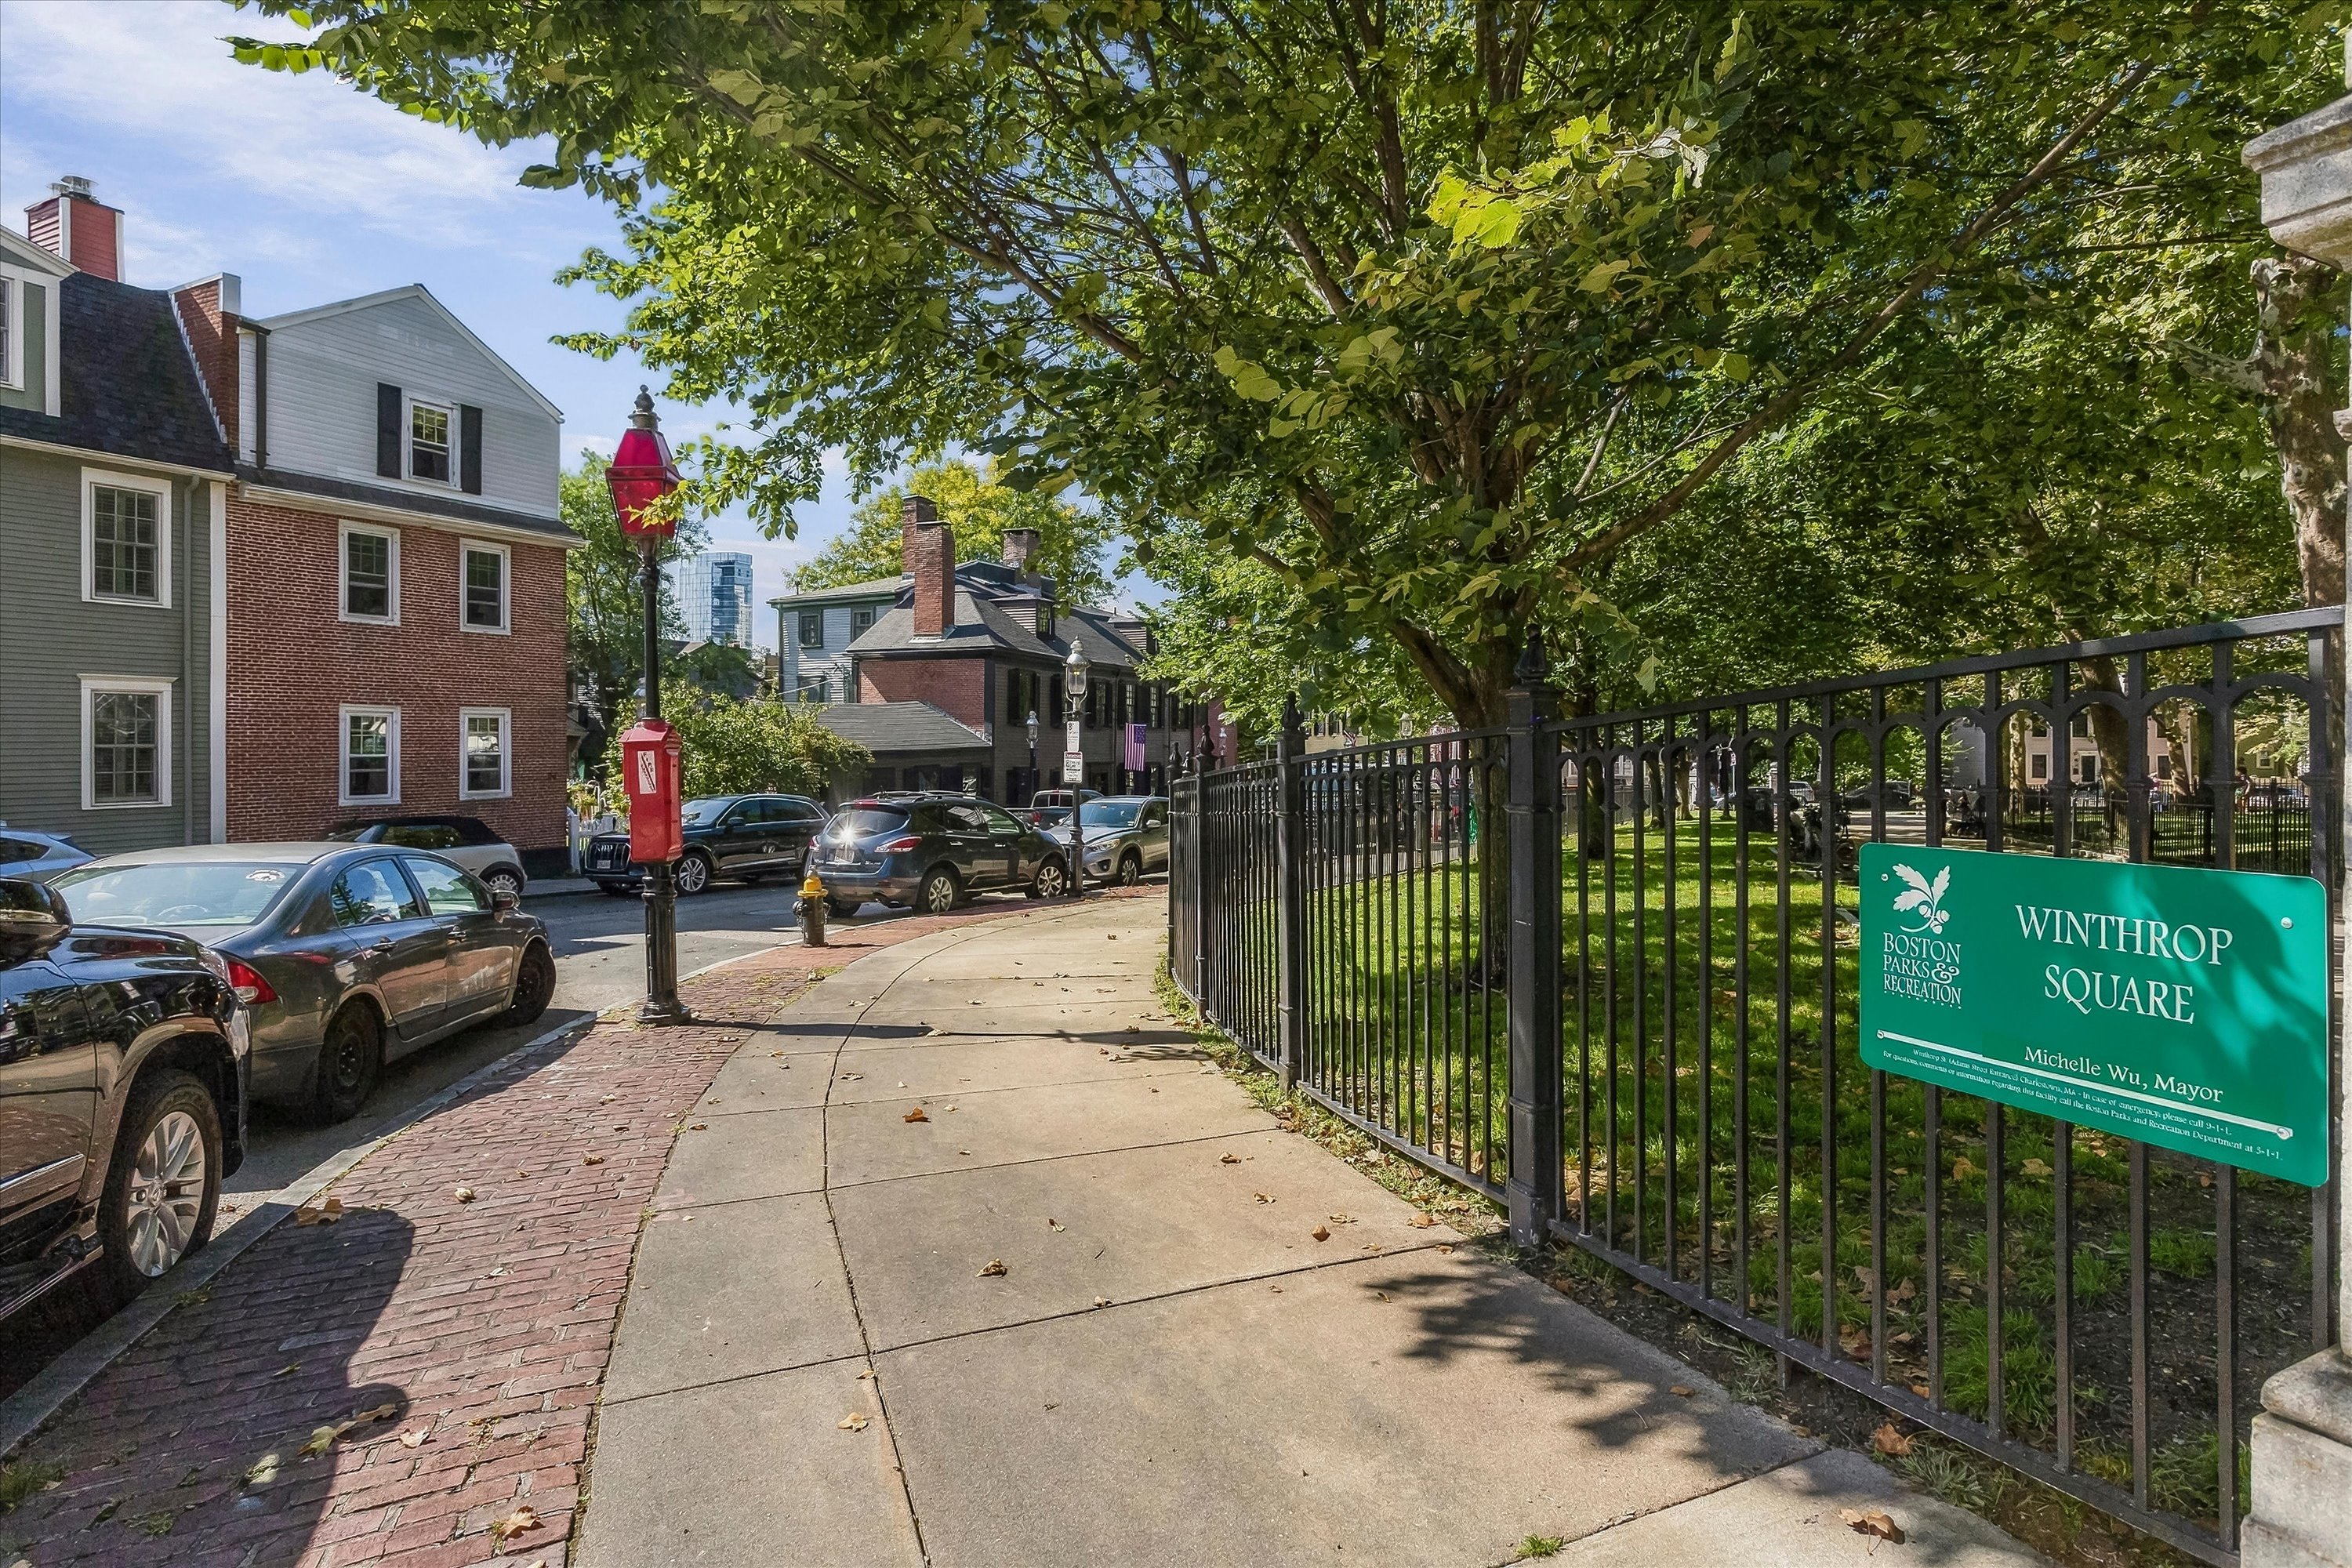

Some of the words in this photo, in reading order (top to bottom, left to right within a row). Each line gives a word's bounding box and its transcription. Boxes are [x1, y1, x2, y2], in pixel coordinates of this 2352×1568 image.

[1883, 931, 1962, 964] BOSTON
[2014, 904, 2234, 965] WINTHROP
[1883, 954, 1929, 978] PARKS
[1931, 962, 1960, 984] &
[1883, 973, 1962, 1005] RECREATION
[2044, 964, 2195, 1025] SQUARE
[1883, 1050, 1892, 1058] For
[1919, 1062, 1947, 1073] comments
[1956, 1070, 1991, 1085] information
[1991, 1079, 2022, 1093] regarding
[2023, 1086, 2034, 1096] this
[2035, 1090, 2058, 1104] facility
[2059, 1097, 2071, 1106] call
[2073, 1099, 2085, 1109] the
[2085, 1103, 2109, 1116] Boston
[2111, 1109, 2131, 1121] Parks
[2132, 1116, 2147, 1125] and
[2148, 1120, 2190, 1137] Recreation
[2192, 1130, 2242, 1150] Department
[2245, 1144, 2253, 1152] at
[1913, 1048, 1940, 1062] Winthrop
[1972, 1063, 1987, 1073] Street
[2063, 1087, 2076, 1096] MA
[2082, 1091, 2091, 1100] In
[2092, 1095, 2107, 1104] case
[2162, 1112, 2187, 1123] please
[2188, 1118, 2204, 1128] call
[2024, 1046, 2101, 1076] Michelle
[2107, 1063, 2148, 1091] Wu,
[2154, 1073, 2224, 1102] Mayor
